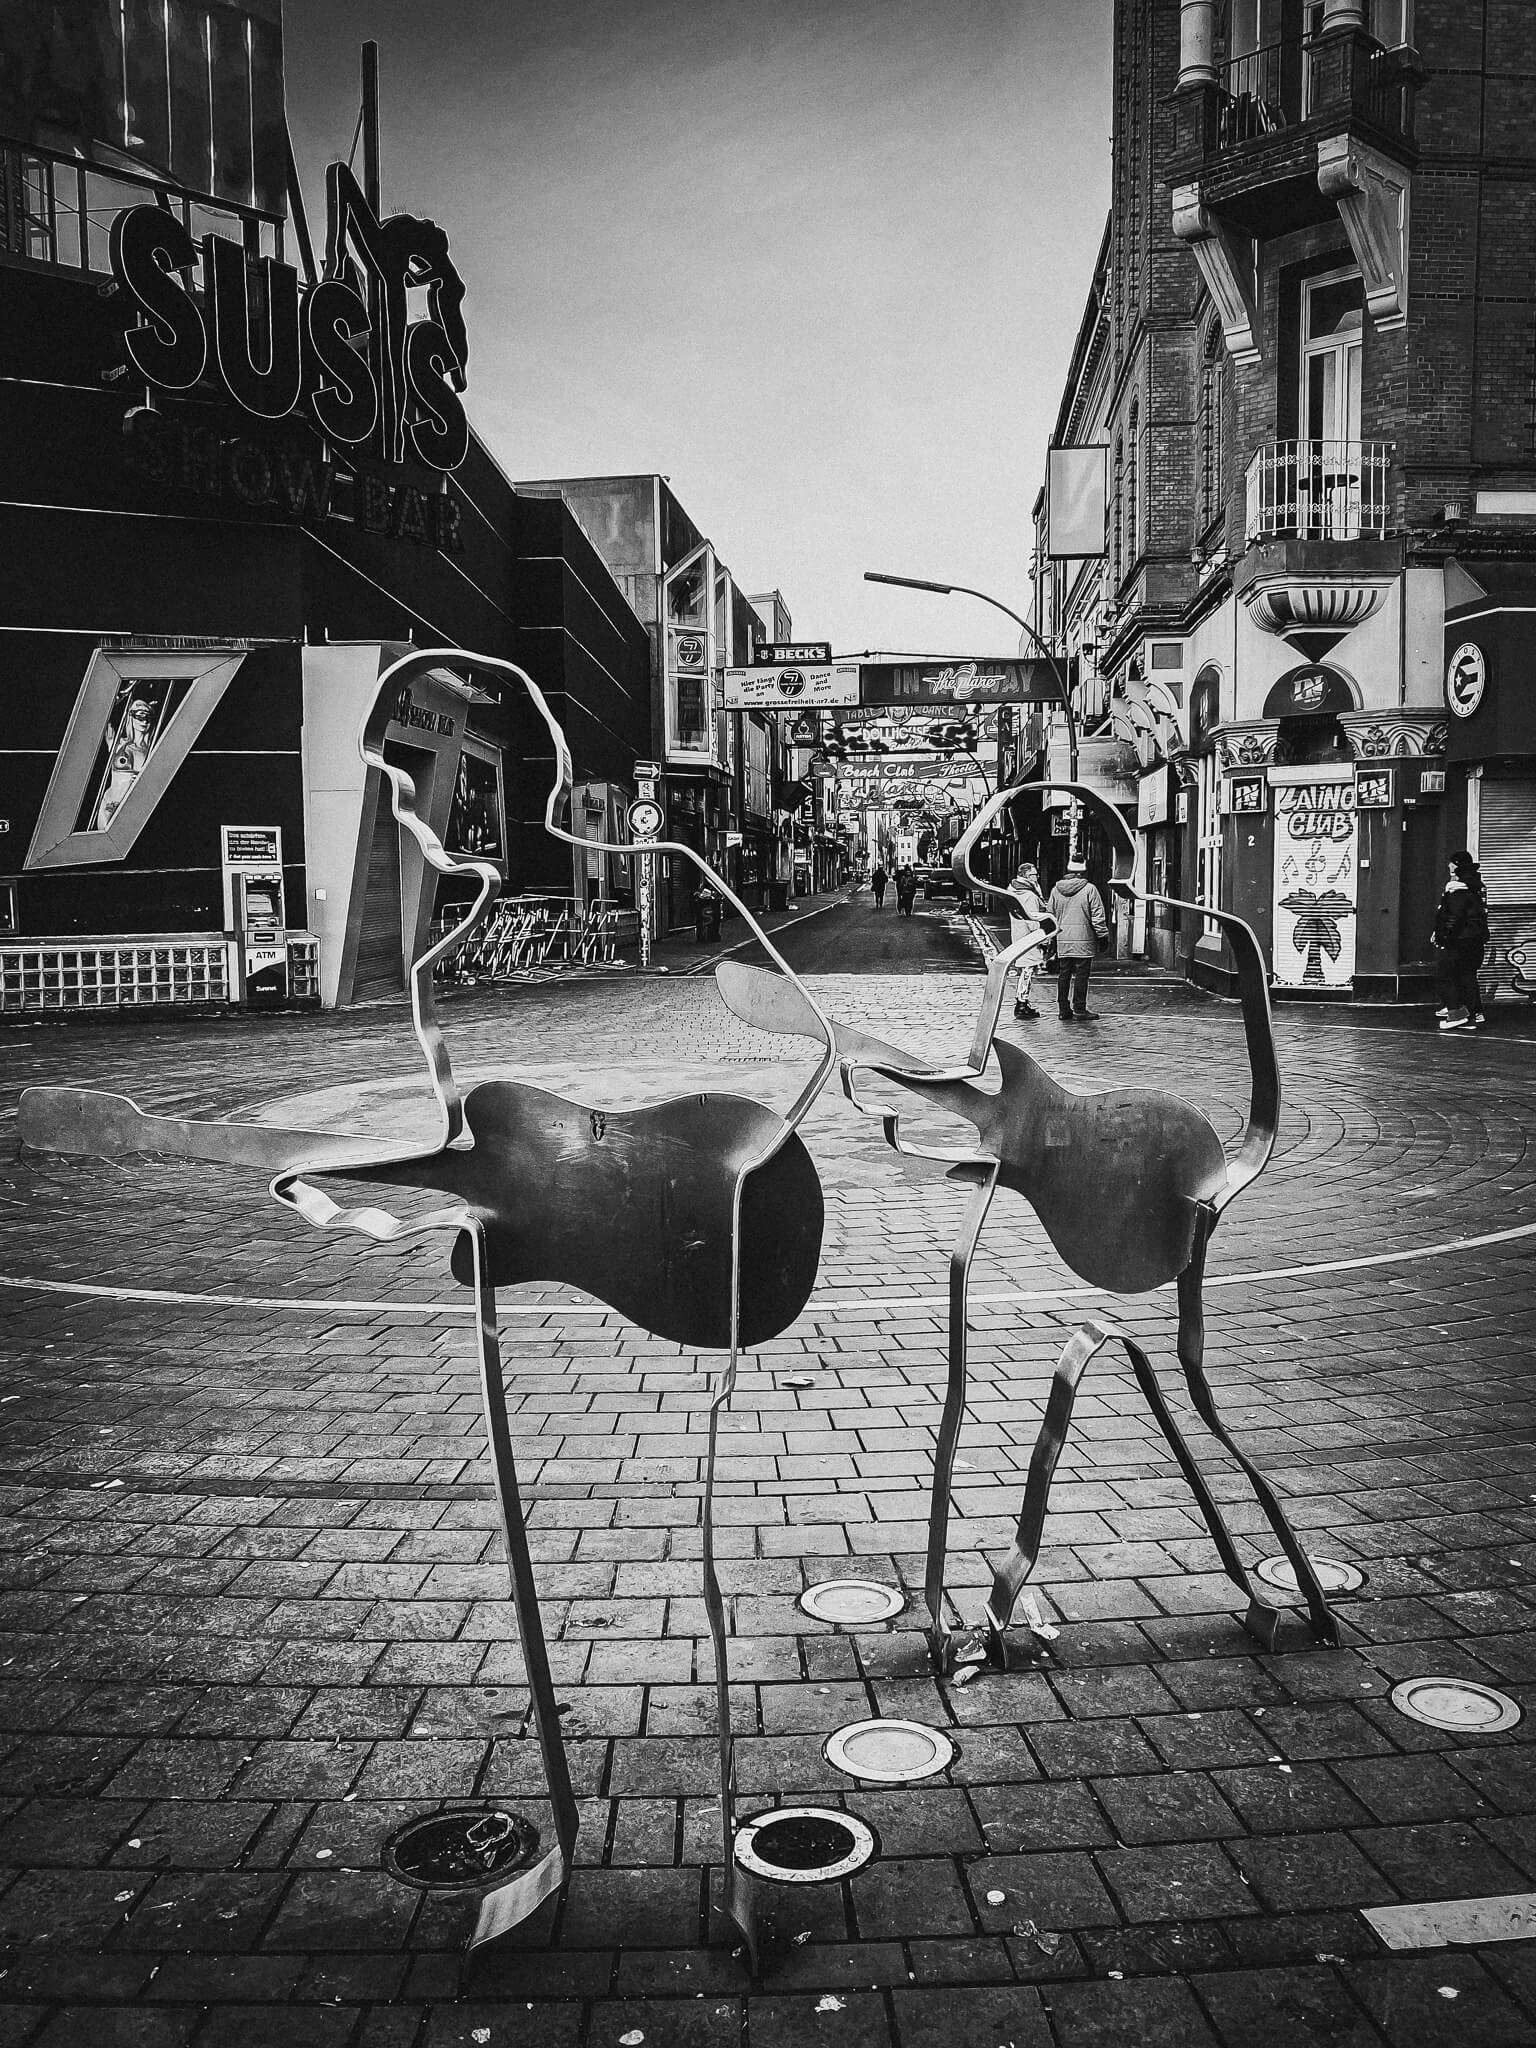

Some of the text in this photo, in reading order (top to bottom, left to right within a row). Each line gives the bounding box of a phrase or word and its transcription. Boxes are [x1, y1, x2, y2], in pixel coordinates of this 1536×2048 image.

[361, 474, 466, 553] BAR
[774, 646, 826, 660] BECK'S
[841, 764, 915, 777] Beach Club
[1247, 835, 1255, 846] 2
[255, 951, 276, 959] ATM
